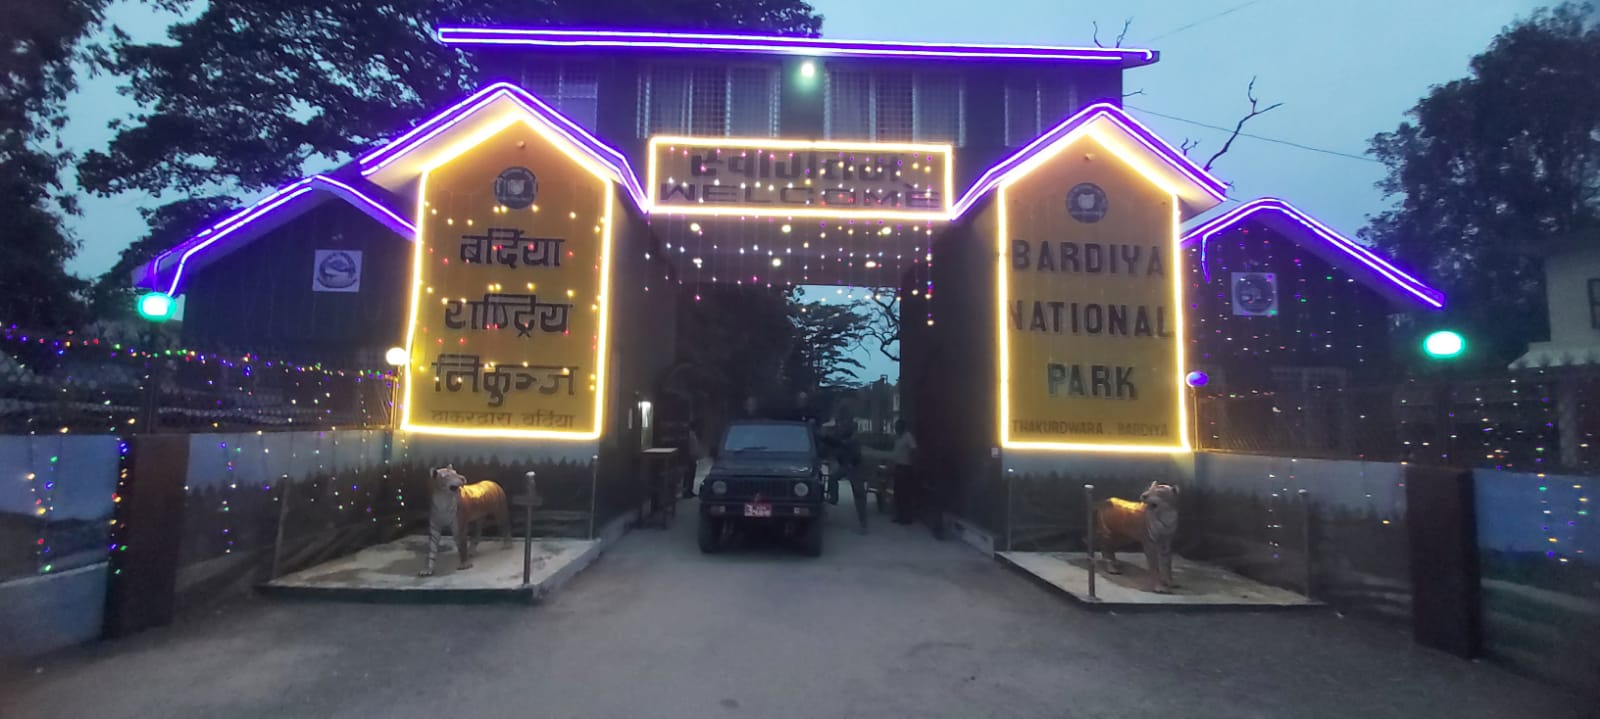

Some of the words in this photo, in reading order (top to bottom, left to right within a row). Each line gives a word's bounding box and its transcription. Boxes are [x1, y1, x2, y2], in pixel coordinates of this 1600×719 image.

[660, 182, 940, 208] WELCOME
[460, 228, 566, 269] बर्दिया
[1012, 239, 1165, 277] BARDIYA
[1008, 300, 1172, 338] NATIONAL
[1047, 363, 1138, 400] PARK
